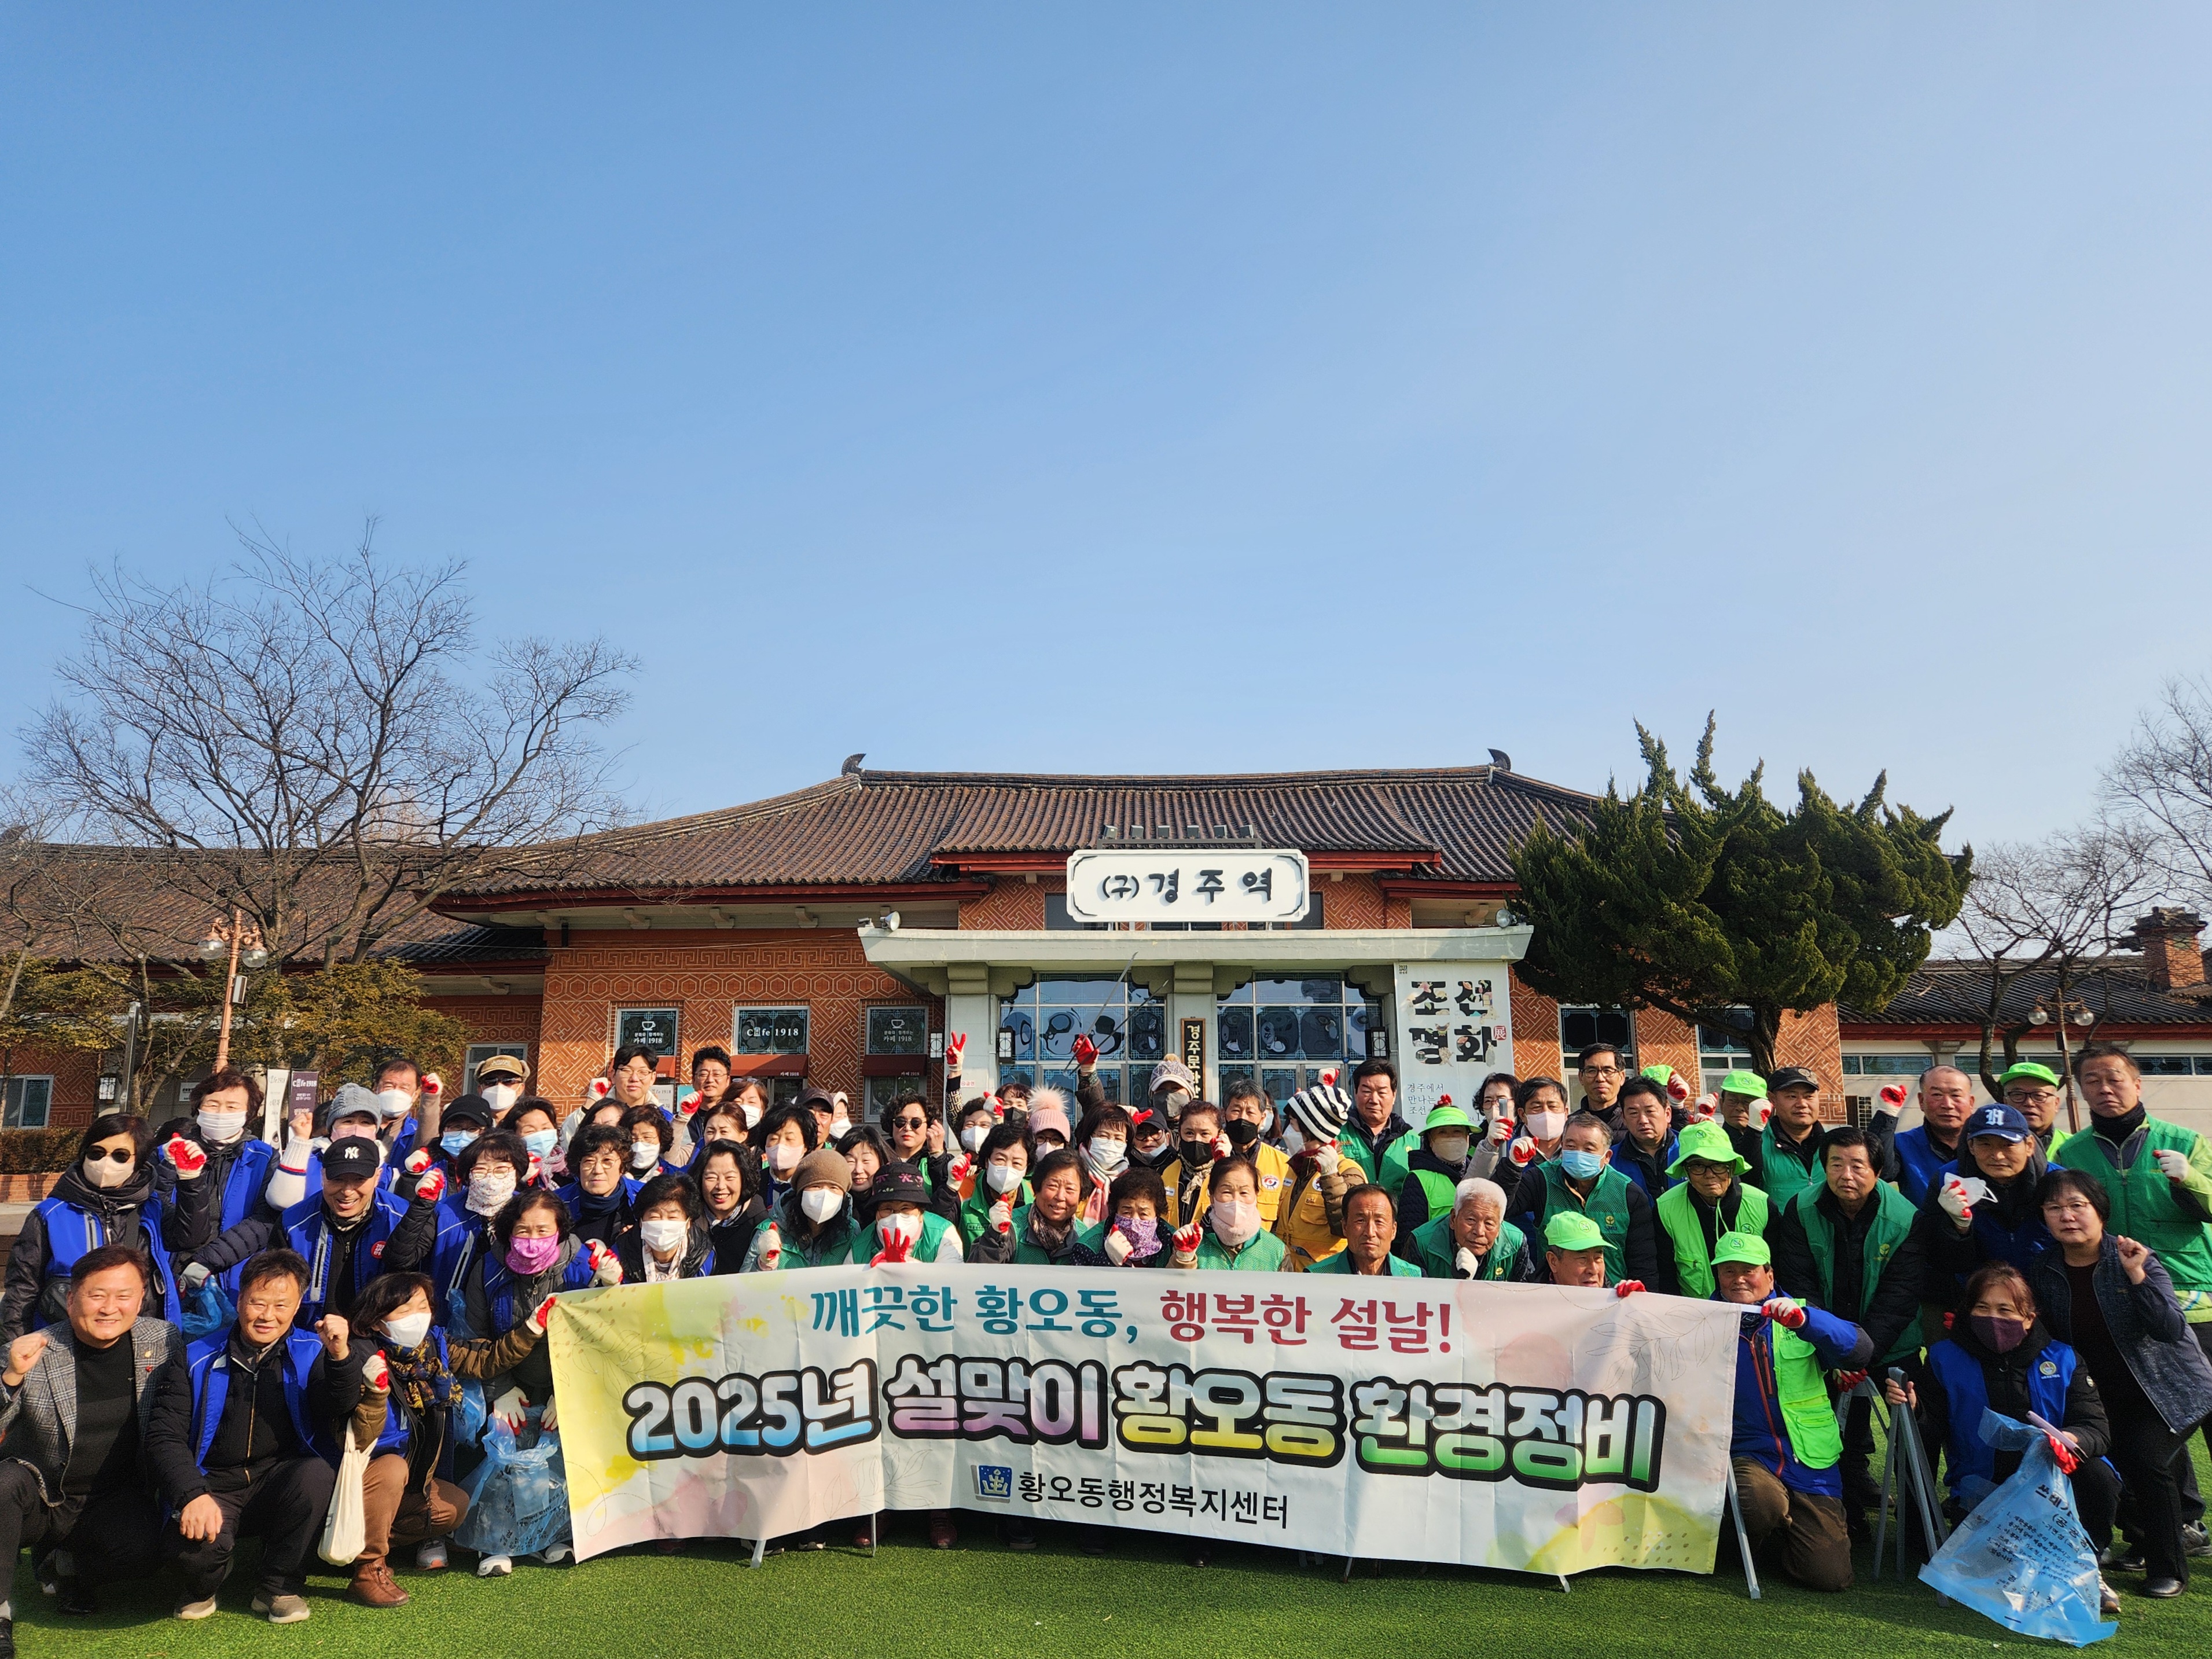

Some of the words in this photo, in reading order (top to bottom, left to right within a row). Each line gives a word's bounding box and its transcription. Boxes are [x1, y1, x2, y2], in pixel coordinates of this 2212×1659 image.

[1411, 979, 1495, 1017] 조선
[775, 1028, 799, 1036] 1918
[1407, 1083, 1445, 1093] 경주에서
[1408, 1095, 1436, 1104] 만나는
[344, 1146, 359, 1159] NY
[811, 1284, 958, 1337] 깨끗한
[975, 1284, 1138, 1344] 황오동,
[1160, 1290, 1312, 1345] 행복한
[1330, 1297, 1452, 1354] 설날!
[622, 1357, 881, 1461] 2025년
[882, 1353, 1108, 1450] 설맞이
[1111, 1360, 1347, 1469] 황오동
[1349, 1376, 1667, 1493] 환경정비
[1017, 1471, 1288, 1529] 황오동행정복지센터
